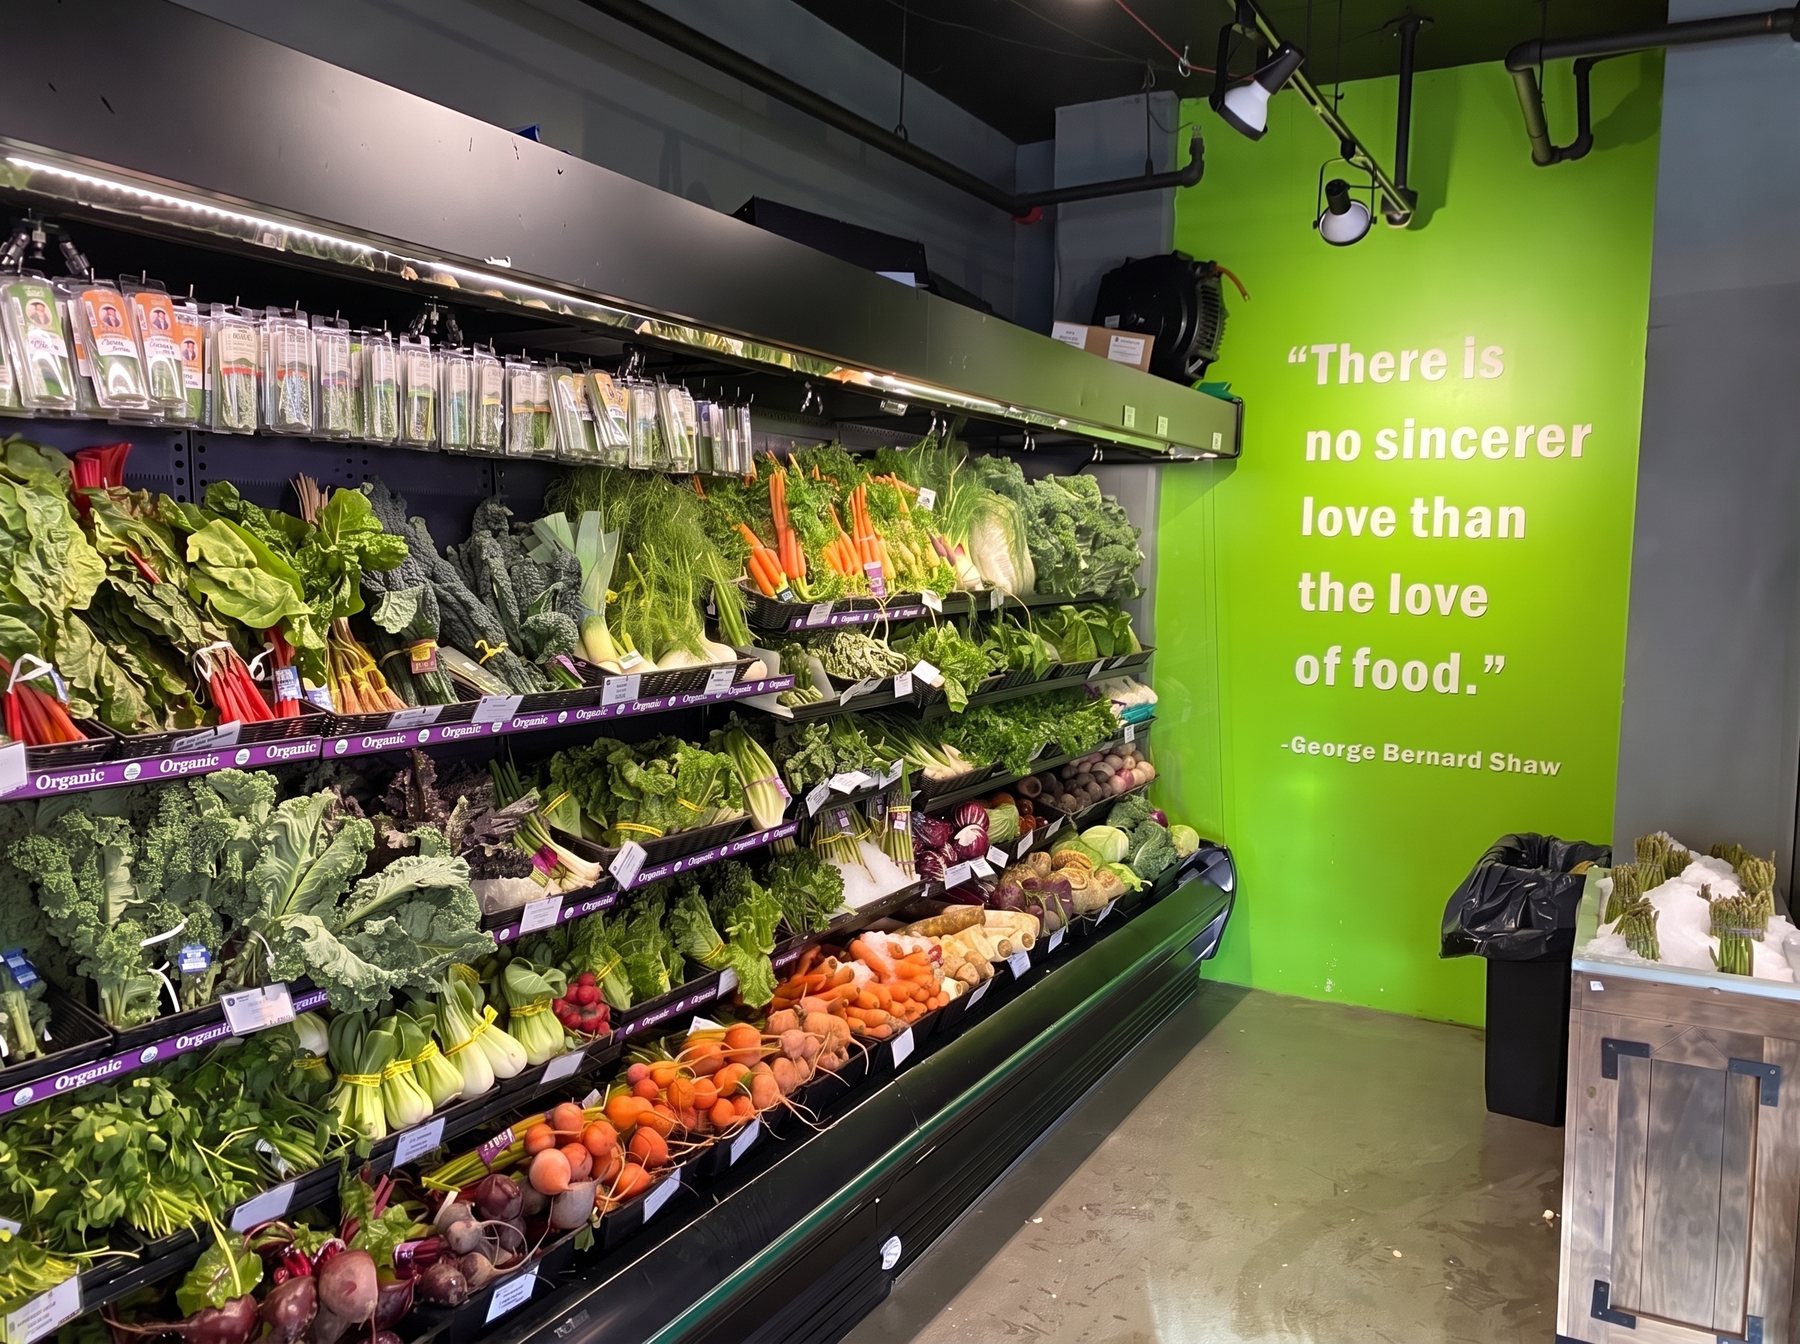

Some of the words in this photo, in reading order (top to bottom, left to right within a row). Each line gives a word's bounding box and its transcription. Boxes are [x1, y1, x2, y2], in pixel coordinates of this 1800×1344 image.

[1288, 342, 1449, 386] “There
[1463, 335, 1505, 380] is
[1305, 428, 1362, 462] no
[1374, 417, 1593, 461] sincerer
[1301, 495, 1397, 538] love
[1409, 495, 1527, 540] than
[1298, 571, 1376, 613] the
[1388, 573, 1489, 619] love
[1294, 645, 1343, 687] of
[1351, 646, 1507, 696] food.”
[361, 733, 406, 750] Organic
[441, 723, 482, 739] Organic
[512, 714, 549, 730] Organic
[576, 706, 608, 720] Organic
[632, 698, 662, 712] Organic
[728, 683, 752, 696] Organic
[769, 677, 791, 690] Organic
[35, 768, 105, 791] Organic
[159, 753, 220, 774] Organic
[265, 740, 317, 760] Organic
[1281, 735, 1377, 764] -George
[1382, 742, 1483, 770] Bernard
[1488, 752, 1562, 777] Shaw
[638, 867, 668, 883] Organic
[687, 851, 715, 867] Organic
[733, 837, 757, 852] Organic
[773, 824, 796, 838] Organic
[581, 895, 614, 912] Organic
[54, 1058, 123, 1091] Organic
[293, 991, 328, 1011] rganic
[641, 1008, 671, 1027] Organic
